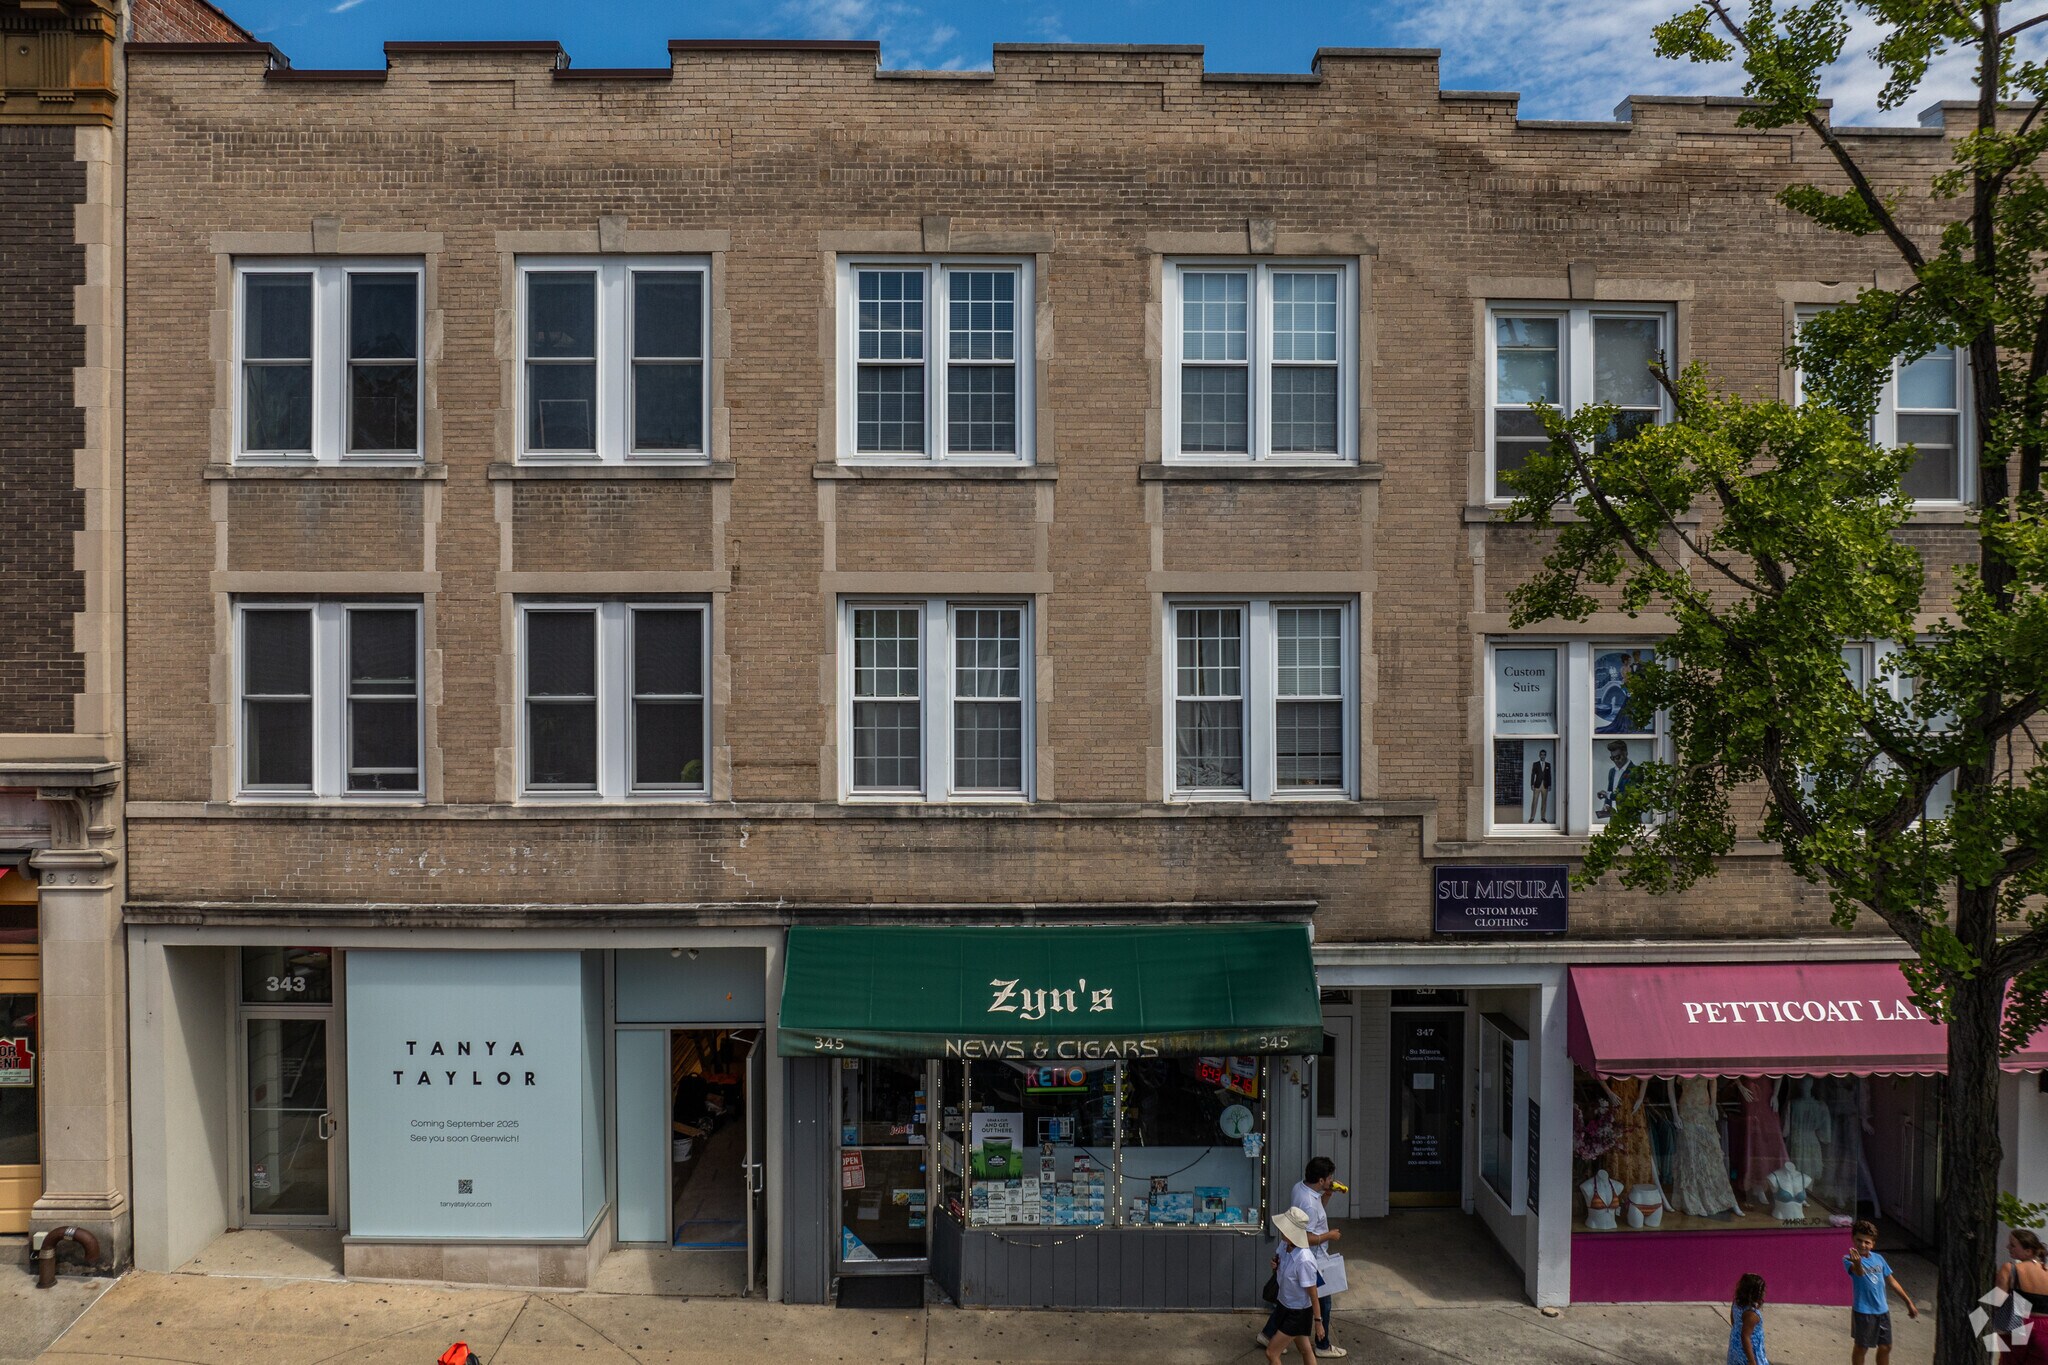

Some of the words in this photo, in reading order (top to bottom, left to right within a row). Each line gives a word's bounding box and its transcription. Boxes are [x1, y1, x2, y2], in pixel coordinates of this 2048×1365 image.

[1504, 666, 1545, 677] Custom
[1513, 682, 1540, 692] Suits
[1438, 880, 1469, 899] SU
[1474, 880, 1565, 899] MISURA
[1465, 907, 1508, 916] CUSTOM
[1510, 907, 1539, 916] MADE
[1474, 918, 1529, 927] CLOTHING
[266, 976, 306, 992] 343
[987, 978, 1114, 1021] Zyn's
[1683, 1000, 1863, 1023] PETTICOAT
[1868, 999, 1940, 1021] LA
[1416, 1028, 1435, 1037] 347
[406, 1041, 524, 1056] TANYA
[814, 1036, 845, 1050] 345
[945, 1038, 1025, 1059] NEWS
[1033, 1041, 1049, 1059] &
[1057, 1039, 1159, 1059] CIGARS
[1259, 1035, 1289, 1049] 345
[0, 1046, 16, 1057] OR
[393, 1071, 536, 1085] TAYLOR
[1026, 1066, 1087, 1087] KENO
[410, 1120, 445, 1129] Coming
[446, 1120, 495, 1129] September
[496, 1120, 519, 1128] 2025
[410, 1134, 427, 1142] See
